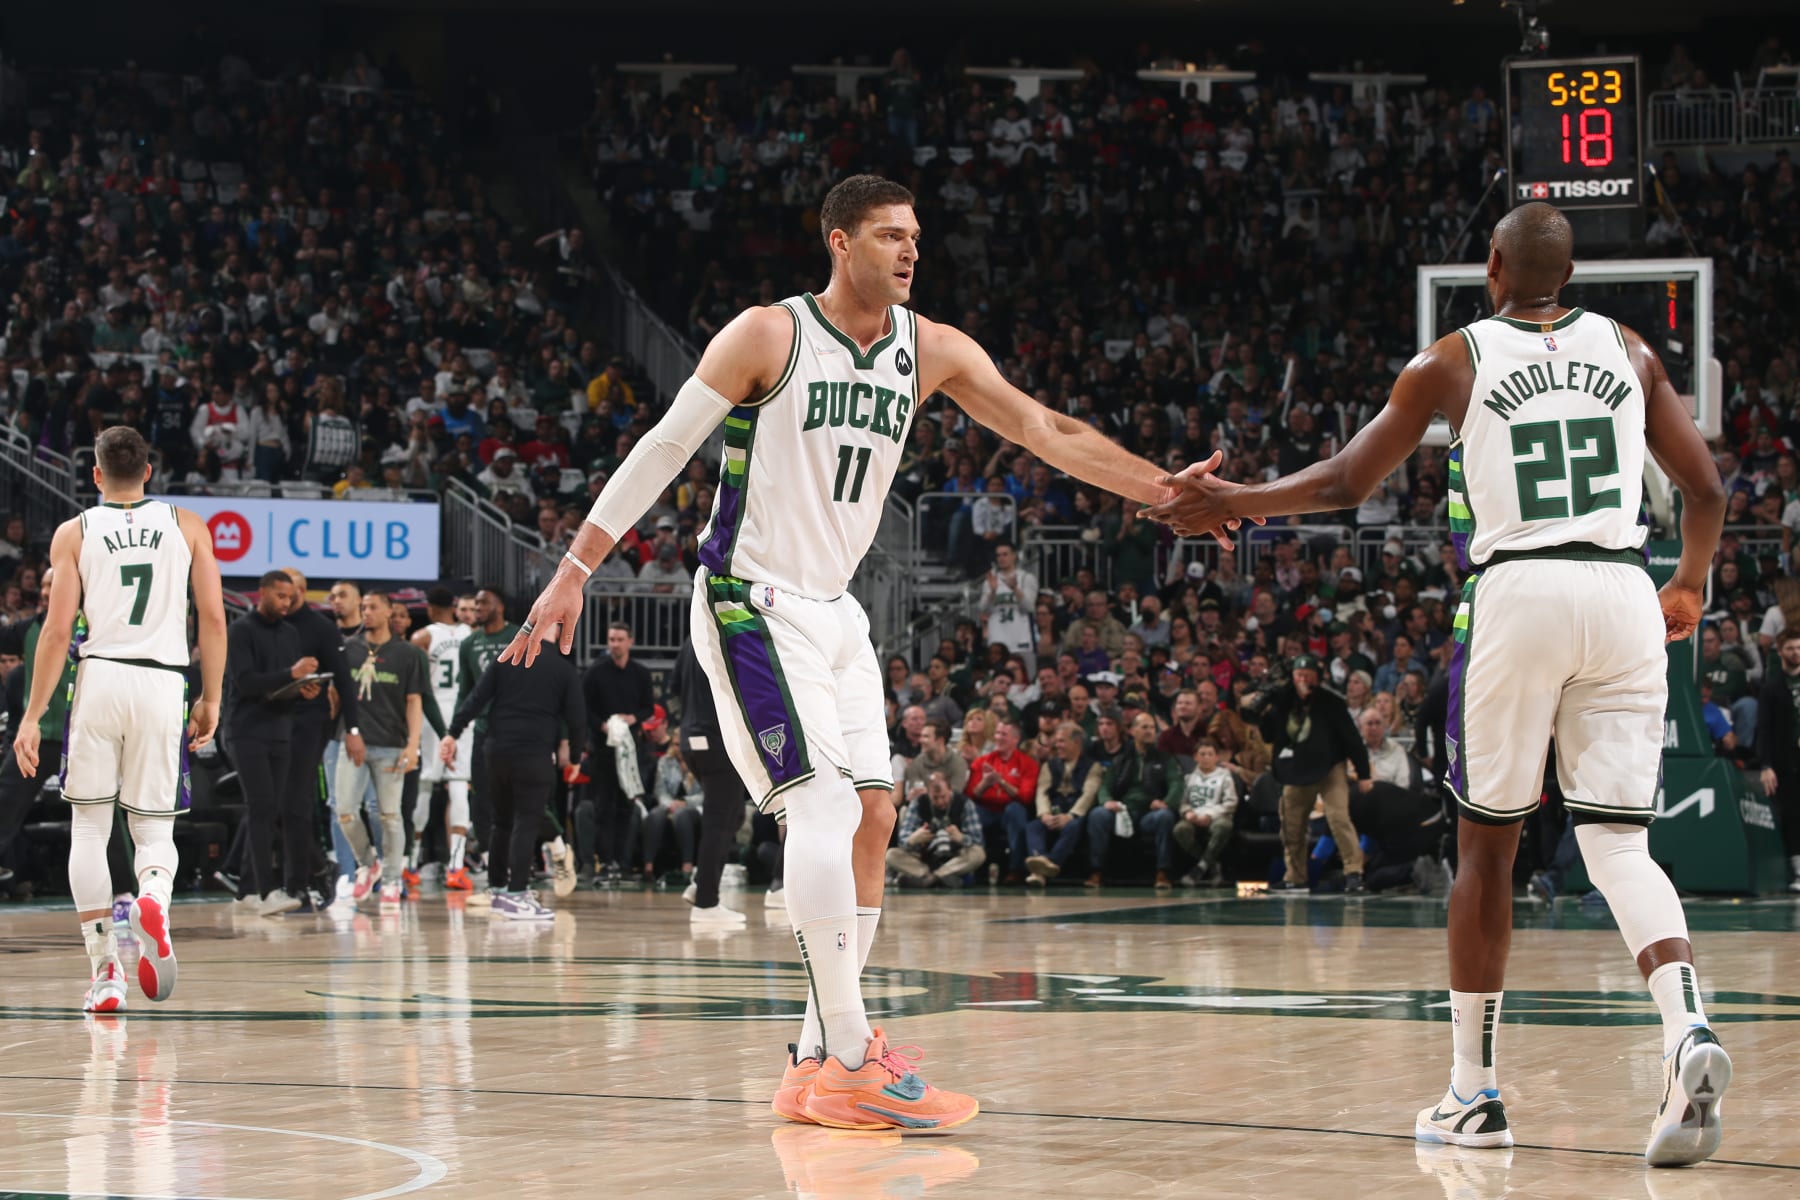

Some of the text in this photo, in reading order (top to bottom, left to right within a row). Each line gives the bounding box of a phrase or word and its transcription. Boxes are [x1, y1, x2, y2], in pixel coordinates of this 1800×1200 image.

[1548, 70, 1622, 106] 5:23
[1561, 108, 1612, 166] 18
[1549, 179, 1633, 198] TISSOT
[803, 380, 911, 444] BUCKS
[1483, 361, 1632, 421] MIDDLETON
[833, 444, 872, 503] 11
[1510, 416, 1621, 522] 22
[103, 528, 163, 554] ALLEN
[288, 518, 411, 561] CLUB
[120, 563, 153, 625] 7
